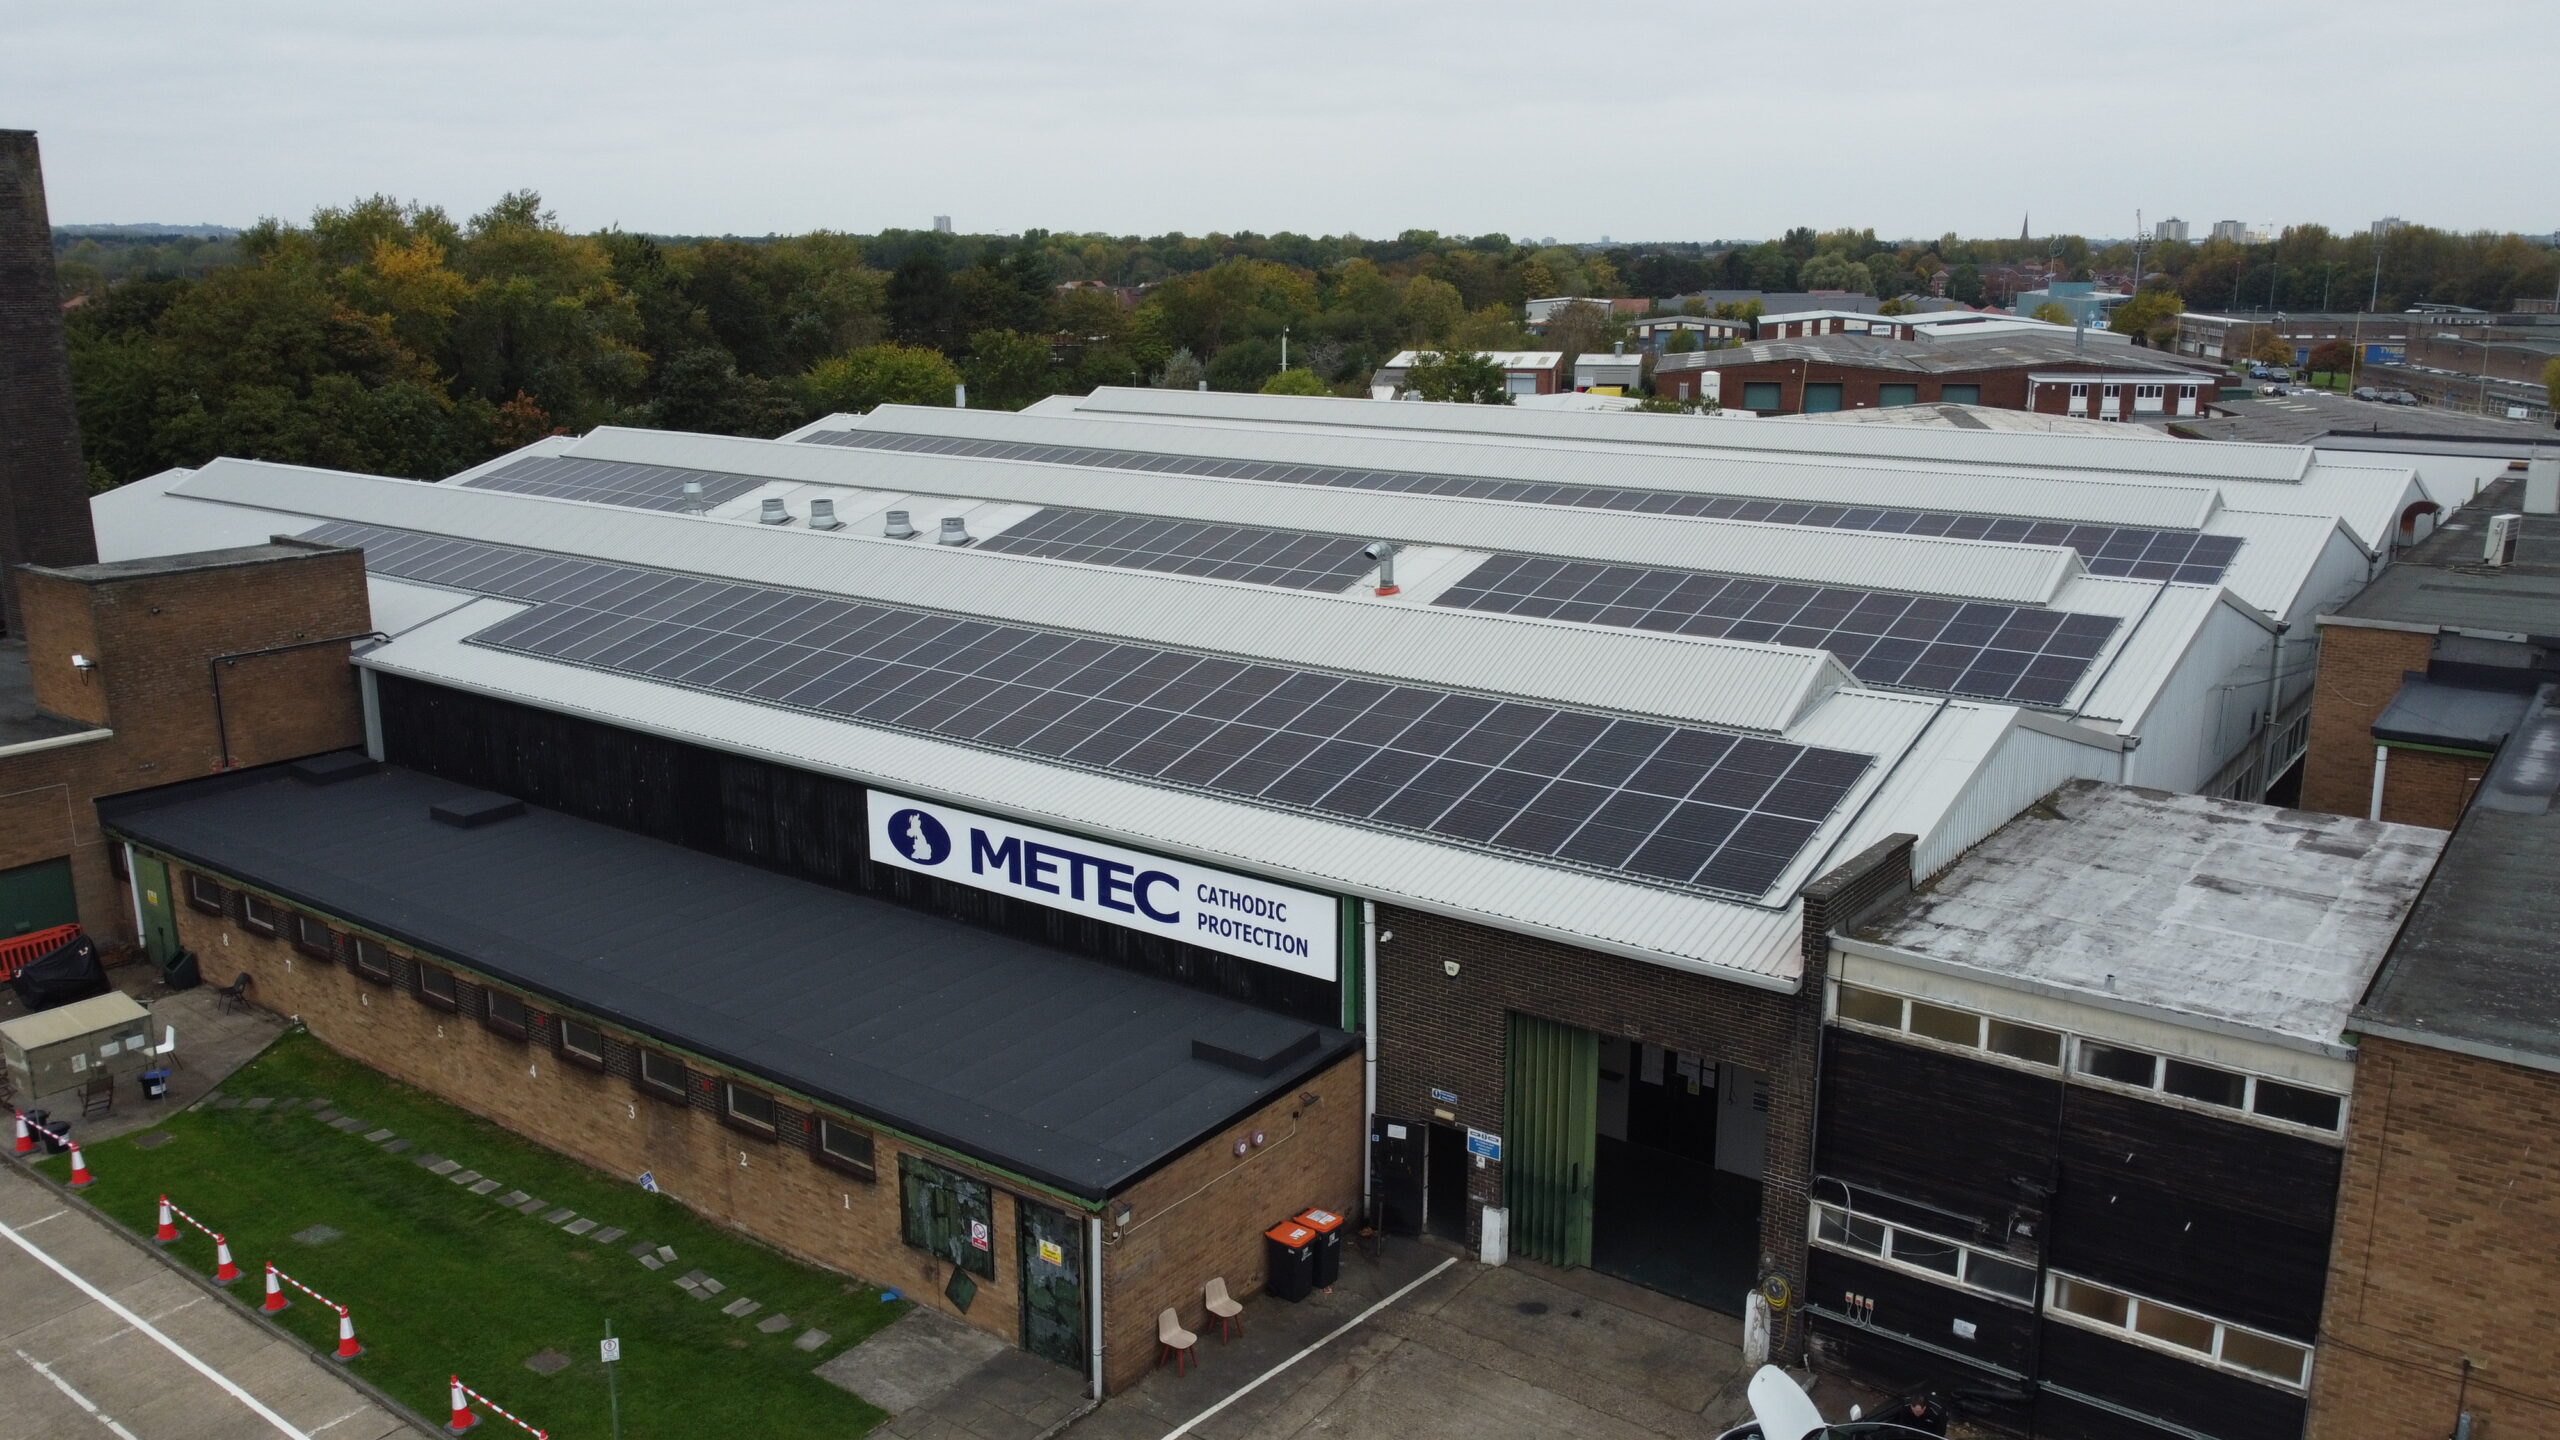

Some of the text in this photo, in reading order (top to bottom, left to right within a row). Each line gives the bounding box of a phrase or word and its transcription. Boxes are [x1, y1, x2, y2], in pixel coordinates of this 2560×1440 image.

[970, 828, 1180, 924] METEC
[1197, 884, 1287, 923] CATHODIC
[222, 933, 229, 946] 8
[1198, 912, 1308, 958] PROTECTION
[285, 959, 292, 973] 7
[361, 993, 368, 1006] 6
[437, 1025, 444, 1038] 5
[529, 1064, 537, 1078] 4
[628, 1104, 636, 1119] 3
[740, 1151, 748, 1167] 2
[843, 1194, 851, 1209] 1
